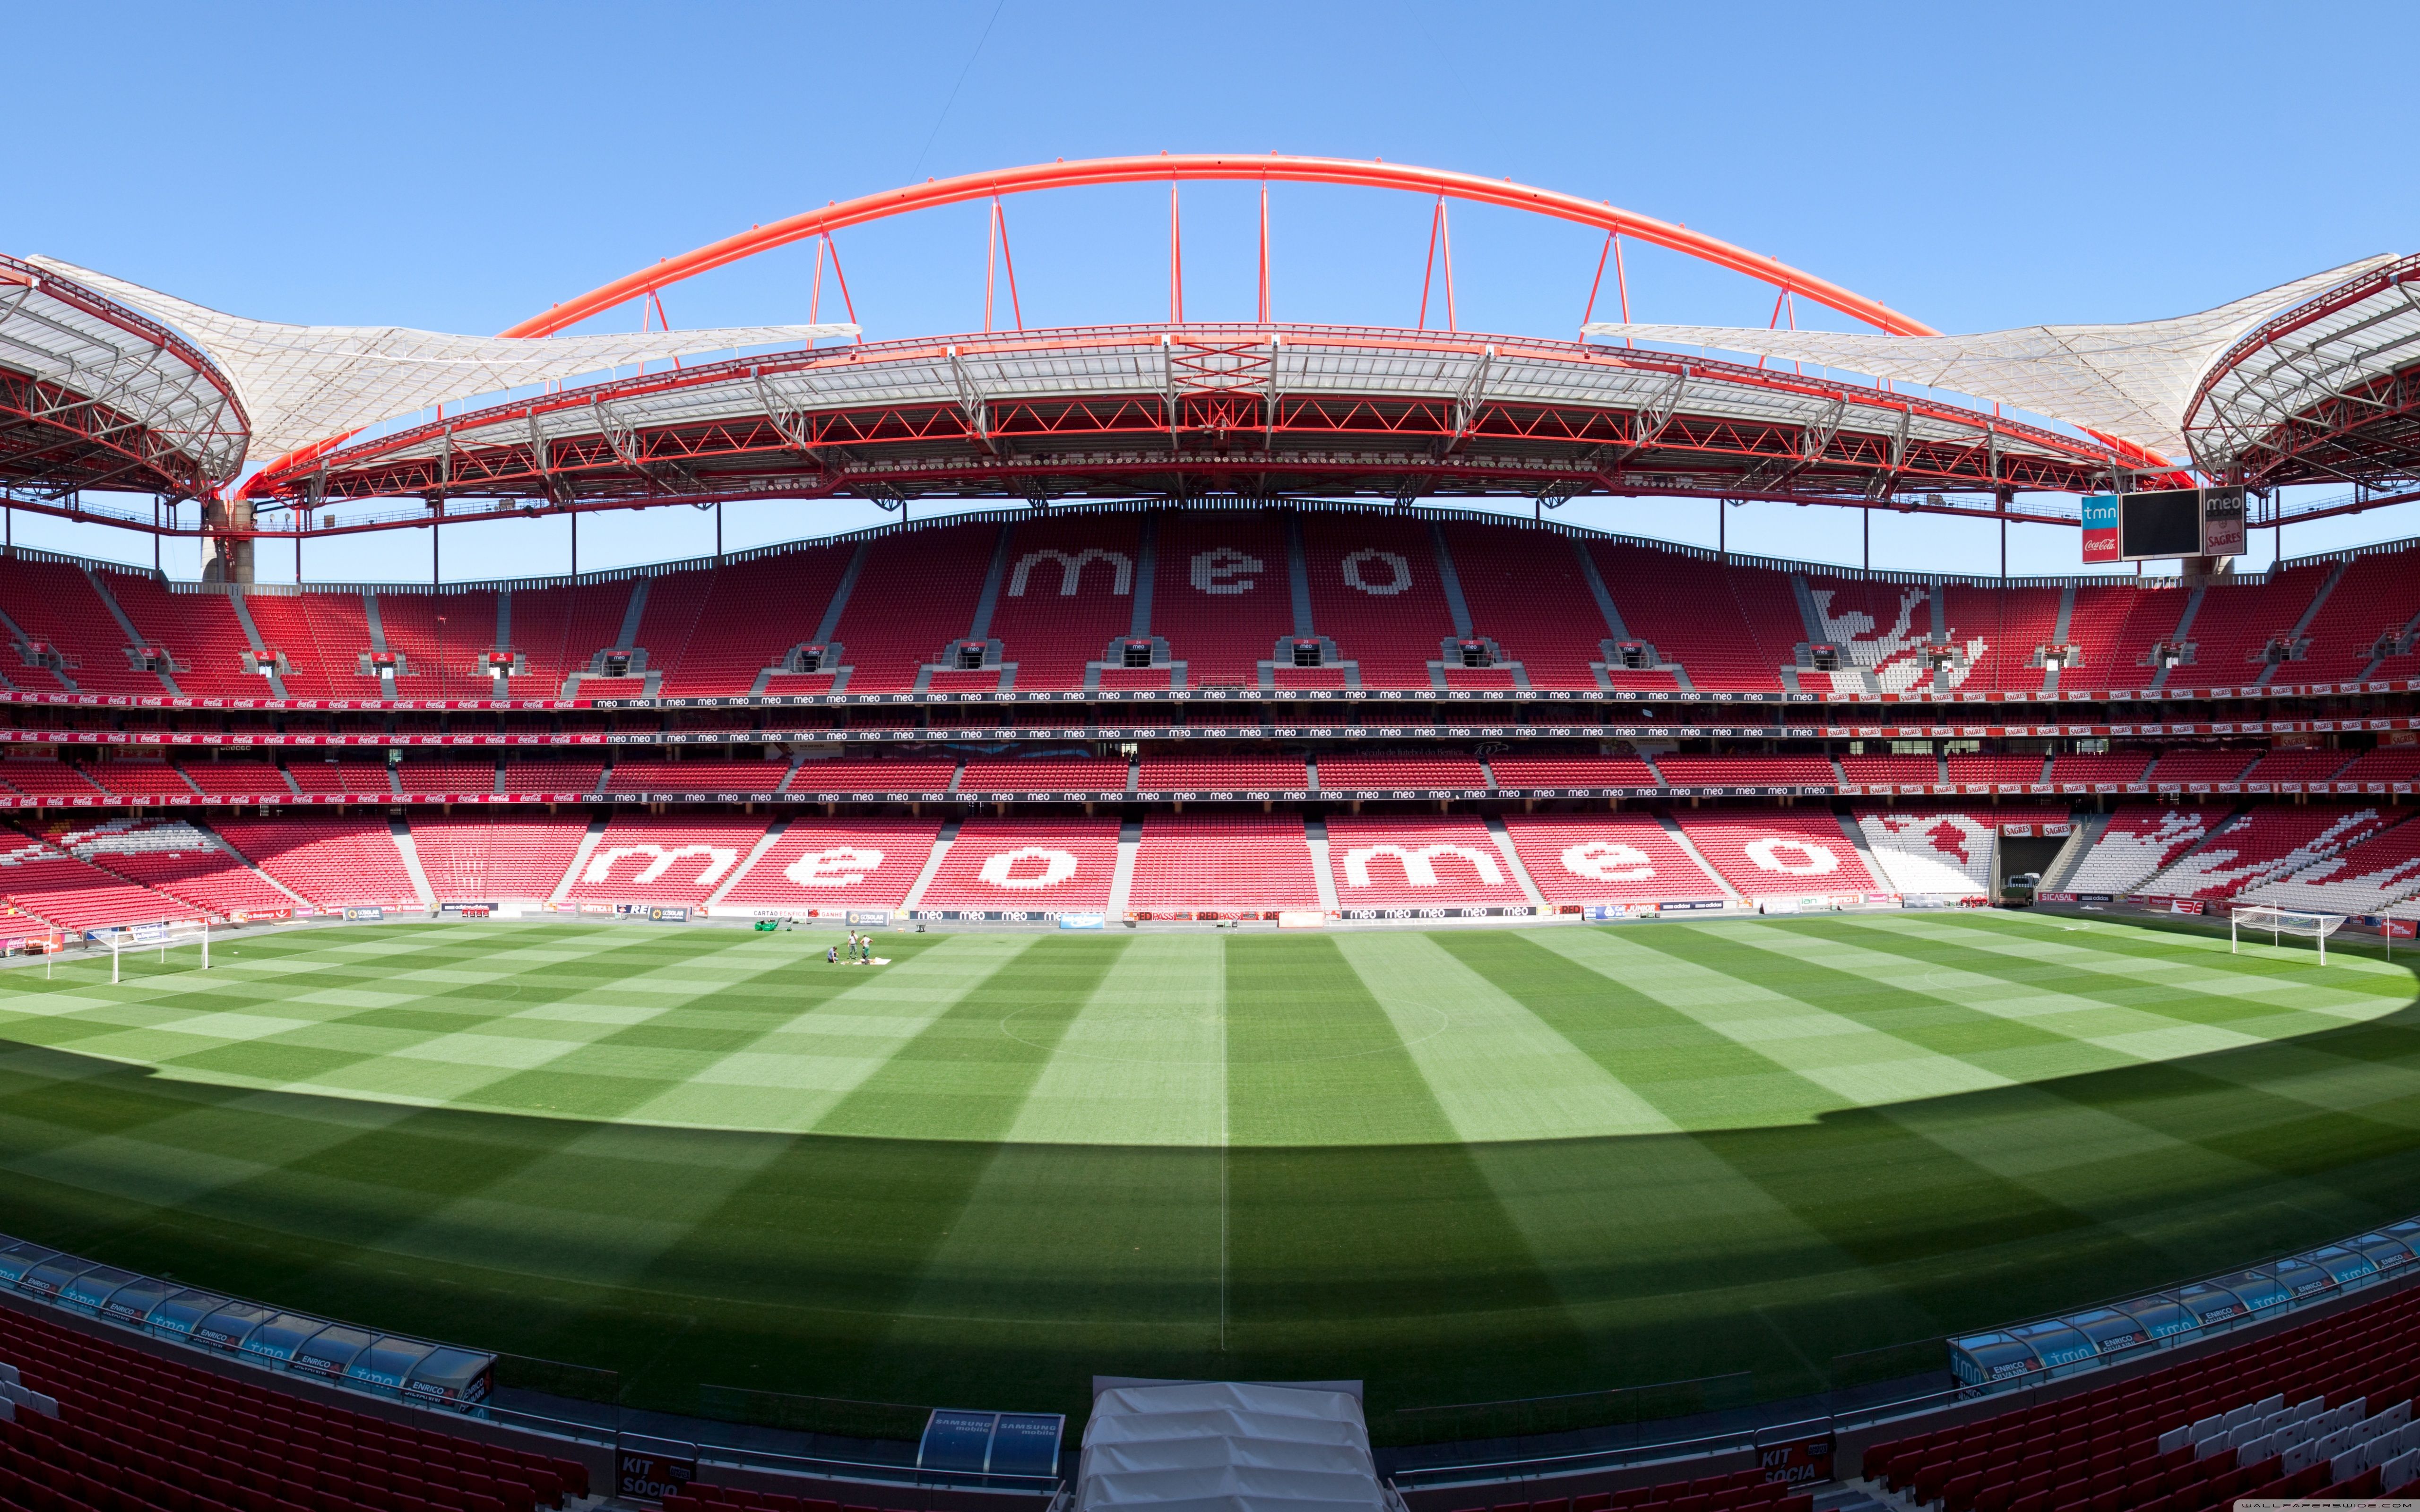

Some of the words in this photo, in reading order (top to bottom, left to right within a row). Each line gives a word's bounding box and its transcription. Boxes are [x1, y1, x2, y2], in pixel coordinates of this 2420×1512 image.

[2207, 497, 2241, 510] meo
[2084, 507, 2116, 519] tmn
[2084, 538, 2116, 551] Coca-Cola
[2208, 532, 2241, 547] SAGRES
[994, 693, 1016, 701] meo
[1275, 691, 1296, 699] meo
[142, 697, 161, 706] Coca-Cola
[266, 700, 284, 708] Coca-Cola
[426, 700, 445, 709] Coca-Cola
[524, 700, 542, 708] Coca-Cola
[20, 731, 39, 740] Coca-Cola
[1064, 730, 1085, 738] meo
[1204, 729, 1226, 737] meo
[173, 735, 191, 744] Coca-Cola
[296, 736, 314, 744] Coca-Cola
[2283, 736, 2306, 747] SAGRES
[2393, 733, 2414, 745] SAGRES
[171, 795, 192, 805] Coca-Cola
[293, 795, 311, 804] Coca-Cola
[459, 794, 477, 803] Coca-Cola
[1247, 792, 1270, 800] meo
[46, 797, 65, 806] Coca-Cola
[2006, 825, 2030, 836] SAGRES
[2045, 824, 2069, 836] SAGRES
[1503, 907, 1529, 916] meo
[1562, 905, 1581, 914] RED
[1627, 903, 1656, 911] JÚNIOR
[918, 911, 943, 919] meo
[959, 911, 985, 920] meo
[1002, 911, 1028, 921] meo
[1044, 912, 1061, 921] me
[1139, 912, 1152, 920] ED
[1153, 912, 1175, 921] PASS
[1199, 911, 1219, 920] RED
[1219, 912, 1241, 920] PASS
[1350, 910, 1376, 919] meo
[1385, 910, 1411, 919] meo
[1419, 909, 1445, 918] meo
[1461, 908, 1487, 917] meo
[2381, 1254, 2403, 1265] ENRICO
[28, 1278, 50, 1289] ENRICO
[2298, 1281, 2322, 1292] ENRICO
[110, 1303, 134, 1315] ENRICO
[2205, 1307, 2232, 1319] ENRICO
[201, 1329, 227, 1341] ENRICO
[2104, 1335, 2132, 1347] ENRICO
[302, 1356, 330, 1368] ENRICO
[1953, 1353, 1981, 1384] tmn
[1994, 1362, 2024, 1374] ENRICO
[413, 1382, 444, 1394] ENRICO
[465, 1377, 484, 1399] ENRICO
[935, 1419, 991, 1427] SAMSUNG
[1762, 1447, 1792, 1467] KIT
[622, 1457, 654, 1474] KIT
[1765, 1464, 1815, 1483] SÓCIA
[622, 1475, 677, 1497] SÓCIO
